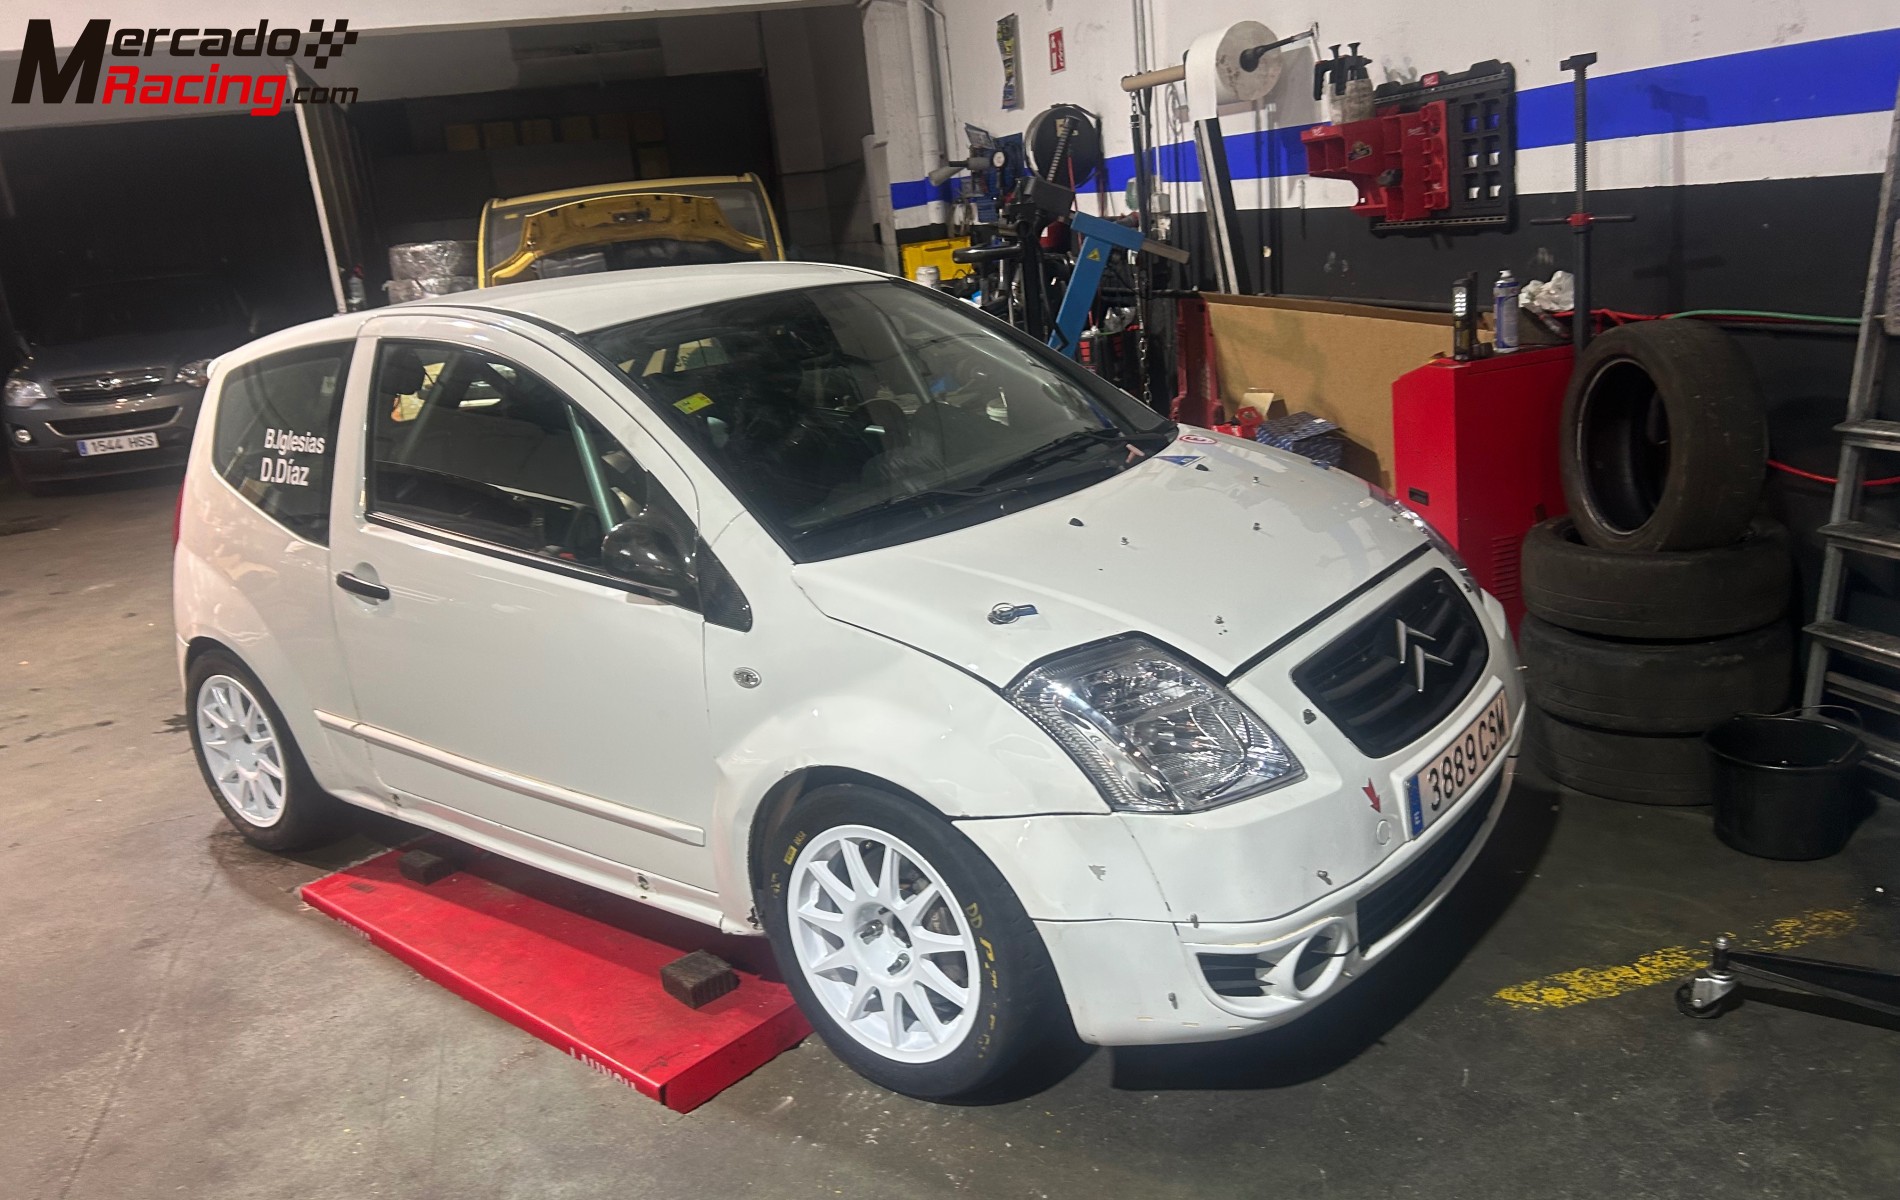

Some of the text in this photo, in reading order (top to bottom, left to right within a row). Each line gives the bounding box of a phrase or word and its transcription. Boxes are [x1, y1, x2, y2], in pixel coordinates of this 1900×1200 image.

[264, 428, 325, 455] B.Iglesias
[260, 457, 310, 486] D.Díaz
[1428, 733, 1476, 811] 3889
